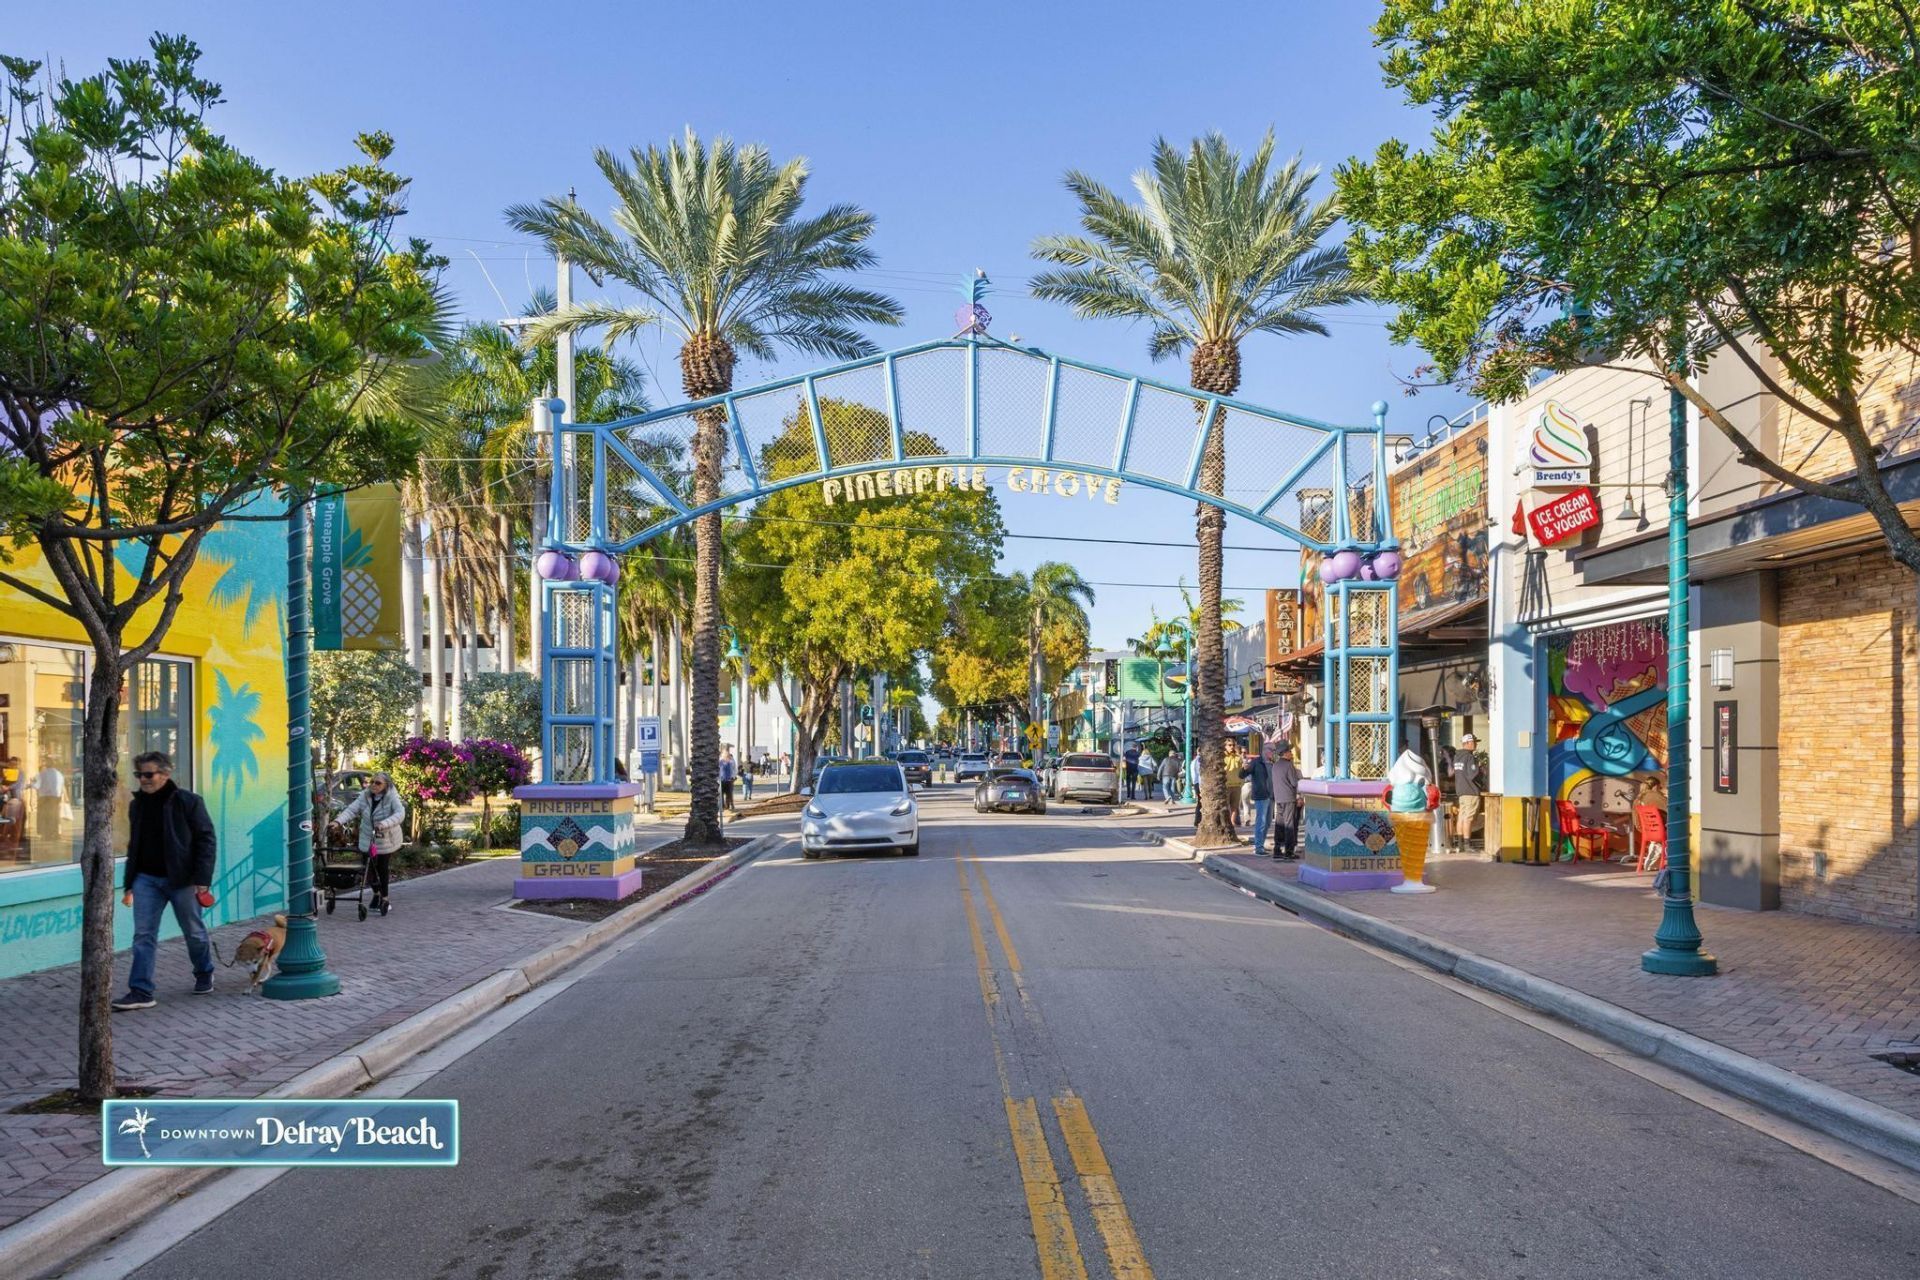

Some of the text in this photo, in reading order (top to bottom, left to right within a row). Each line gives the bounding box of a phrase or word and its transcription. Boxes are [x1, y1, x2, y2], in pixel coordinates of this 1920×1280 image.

[822, 466, 1125, 505] PINEAPPLE GROVE
[1536, 470, 1581, 482] Brendy's
[1536, 493, 1590, 526] ICE CREAM
[321, 502, 336, 564] Pineapple
[1543, 507, 1594, 540] & YOGURT
[321, 569, 333, 605] Grove
[643, 727, 653, 739] P
[529, 800, 609, 813] PINEAPPLE
[534, 864, 601, 876] GROVE
[1341, 858, 1402, 870] DISTRIC
